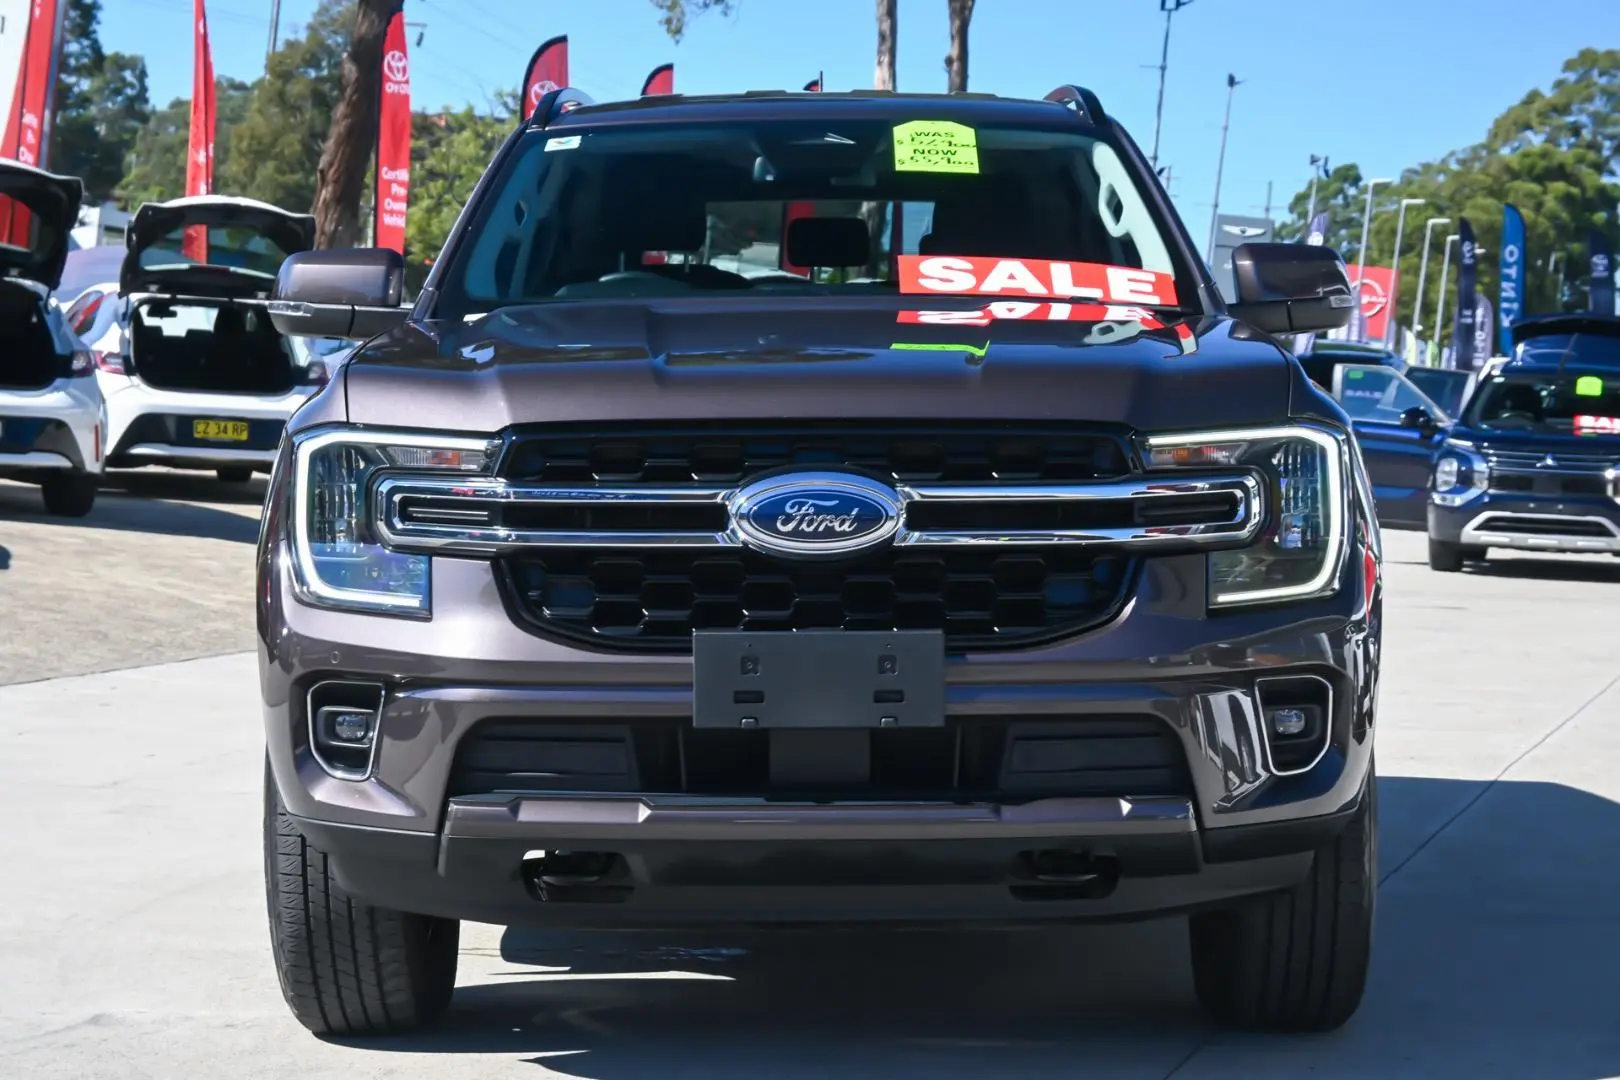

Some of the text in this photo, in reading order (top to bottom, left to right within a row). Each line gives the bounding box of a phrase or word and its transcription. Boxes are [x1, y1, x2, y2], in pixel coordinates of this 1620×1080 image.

[912, 148, 957, 156] NOW
[917, 257, 1161, 305] SALE
[776, 498, 860, 533] Ford
